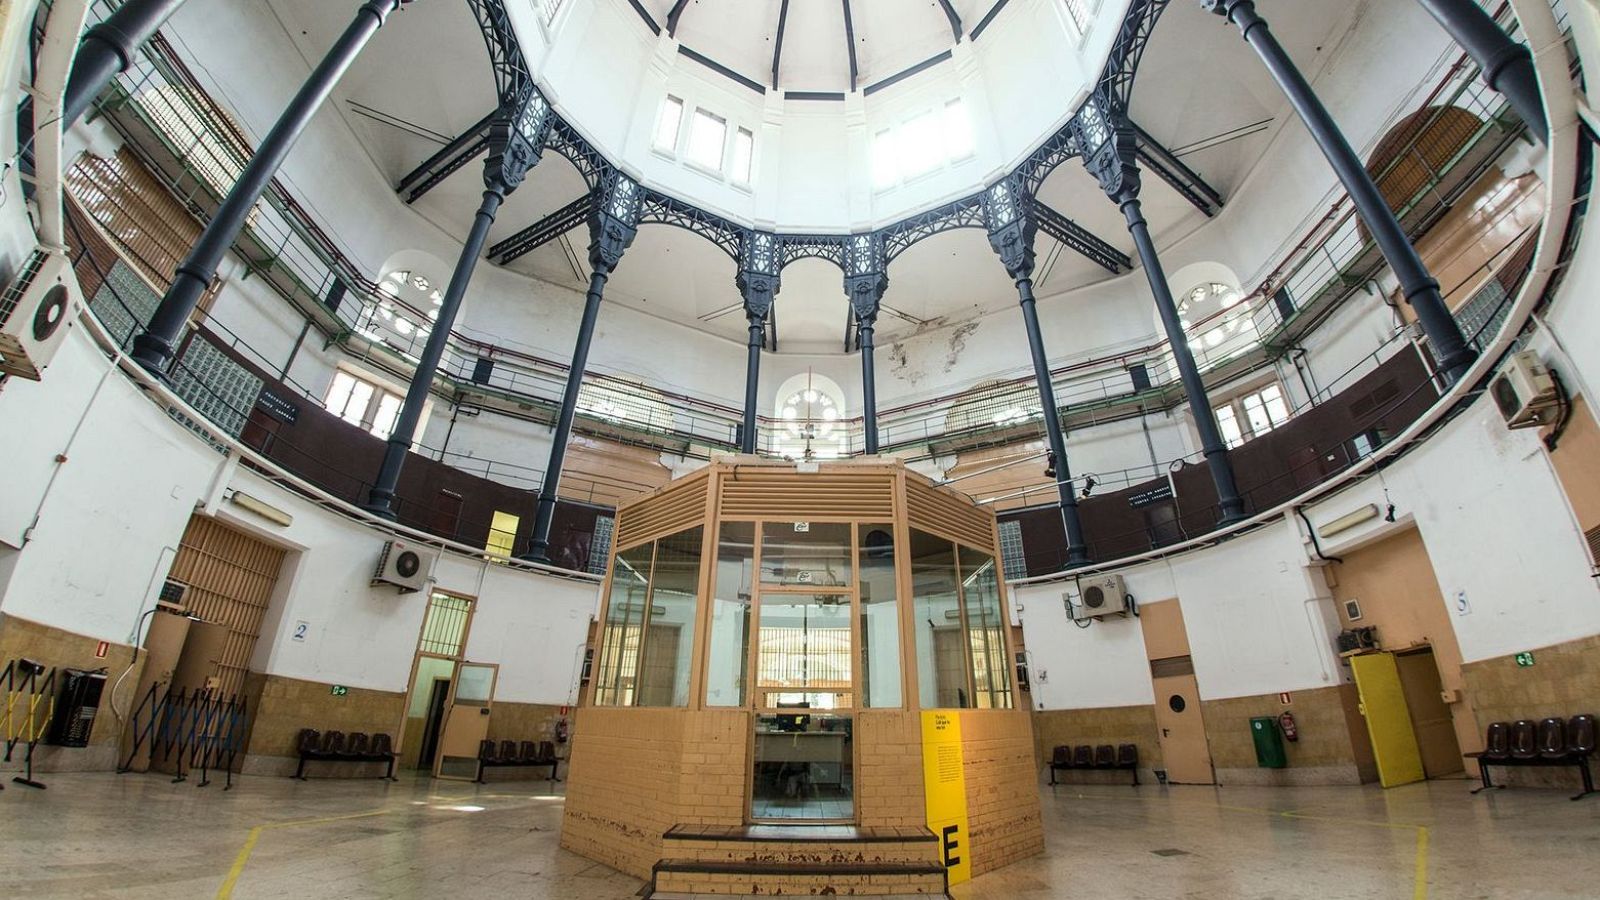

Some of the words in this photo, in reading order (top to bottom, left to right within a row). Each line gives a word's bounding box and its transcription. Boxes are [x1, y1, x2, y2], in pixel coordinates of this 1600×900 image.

[1457, 591, 1467, 612] 5
[294, 624, 307, 639] 2
[943, 824, 961, 868] E
